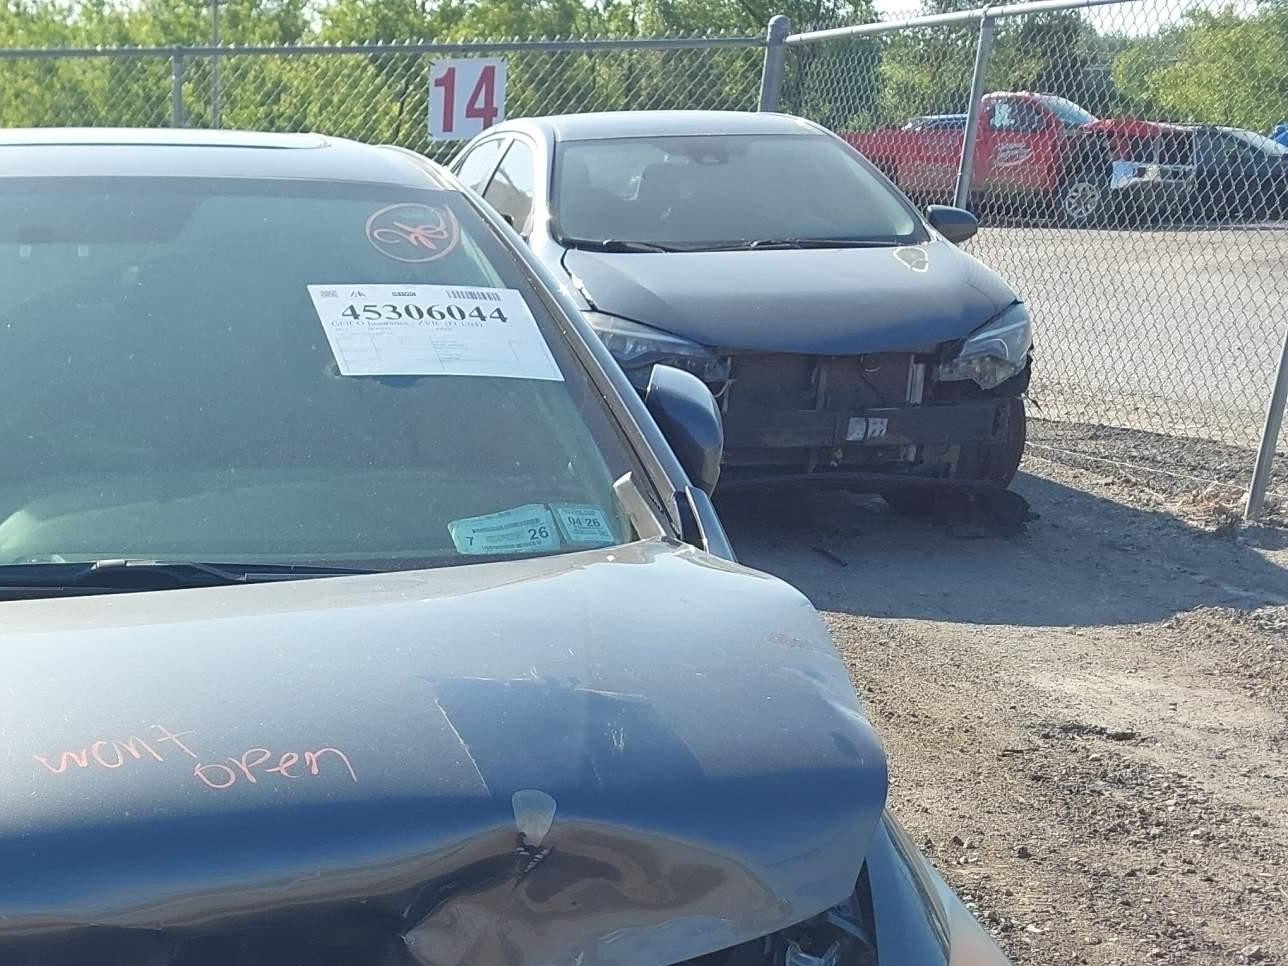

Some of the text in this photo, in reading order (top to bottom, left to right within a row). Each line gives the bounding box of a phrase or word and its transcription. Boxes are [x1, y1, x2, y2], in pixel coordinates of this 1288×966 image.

[434, 65, 498, 132] 14
[341, 303, 508, 323] 45306044
[528, 526, 549, 541] 26
